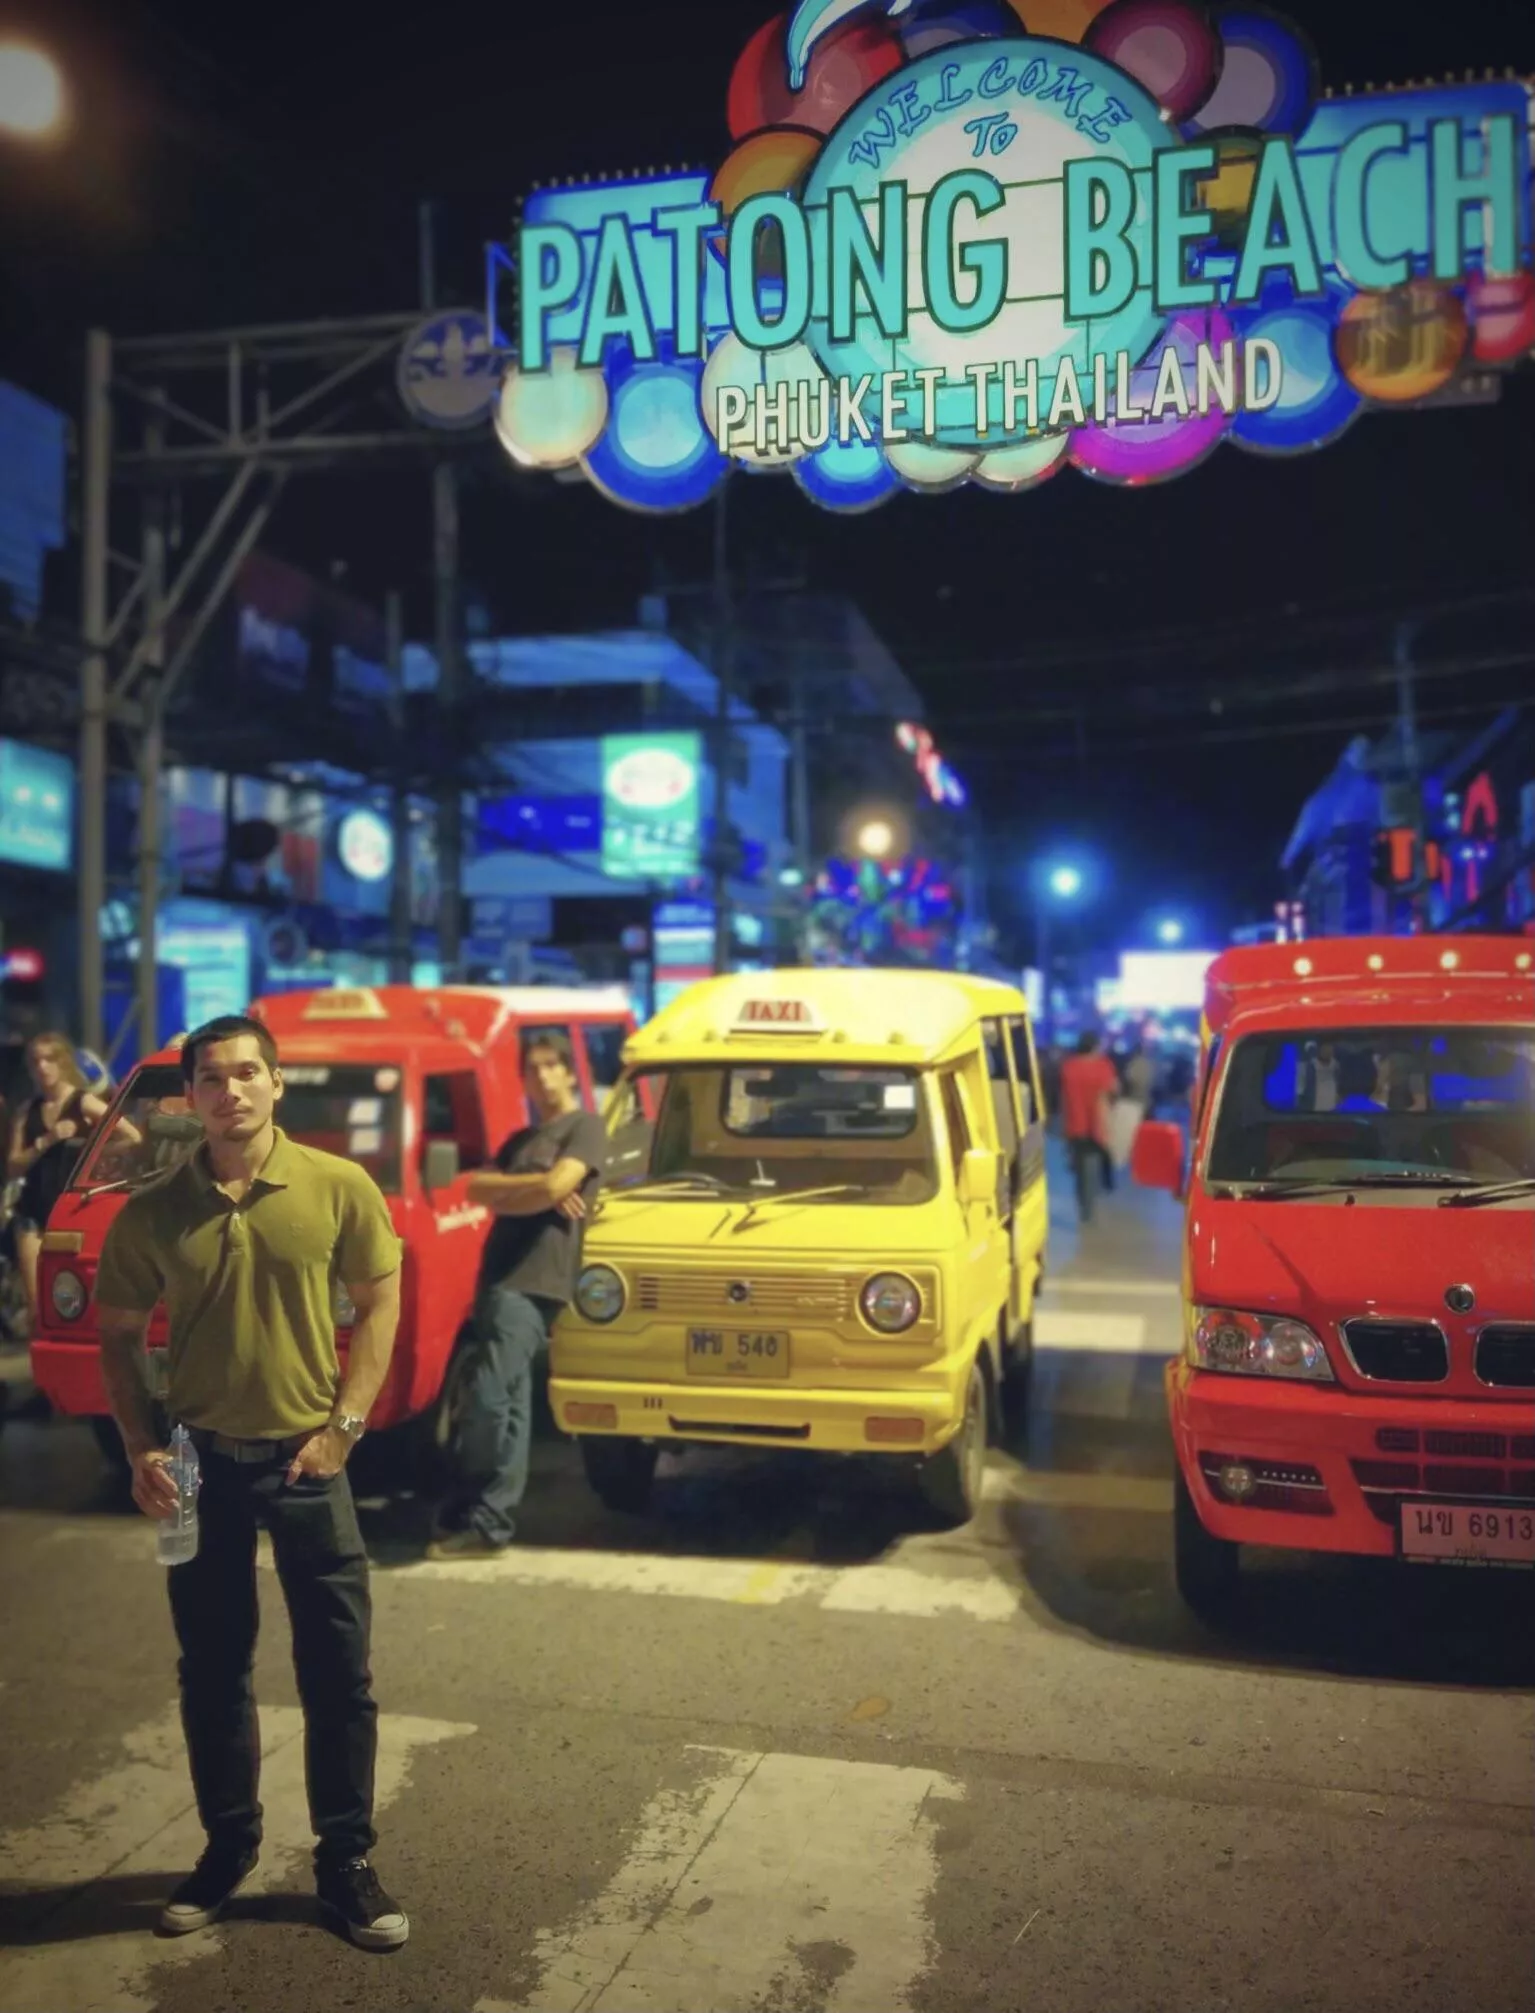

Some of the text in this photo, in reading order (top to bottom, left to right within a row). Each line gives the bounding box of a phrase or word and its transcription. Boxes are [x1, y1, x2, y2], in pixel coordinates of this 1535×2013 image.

[849, 57, 1132, 169] WELCOME
[964, 112, 1018, 157] TO
[518, 112, 1518, 374] PATONG BEACH
[716, 337, 1285, 455] PHUKET THAILAND
[748, 1000, 802, 1021] TAXI
[1415, 1509, 1533, 1540] นข 6913
